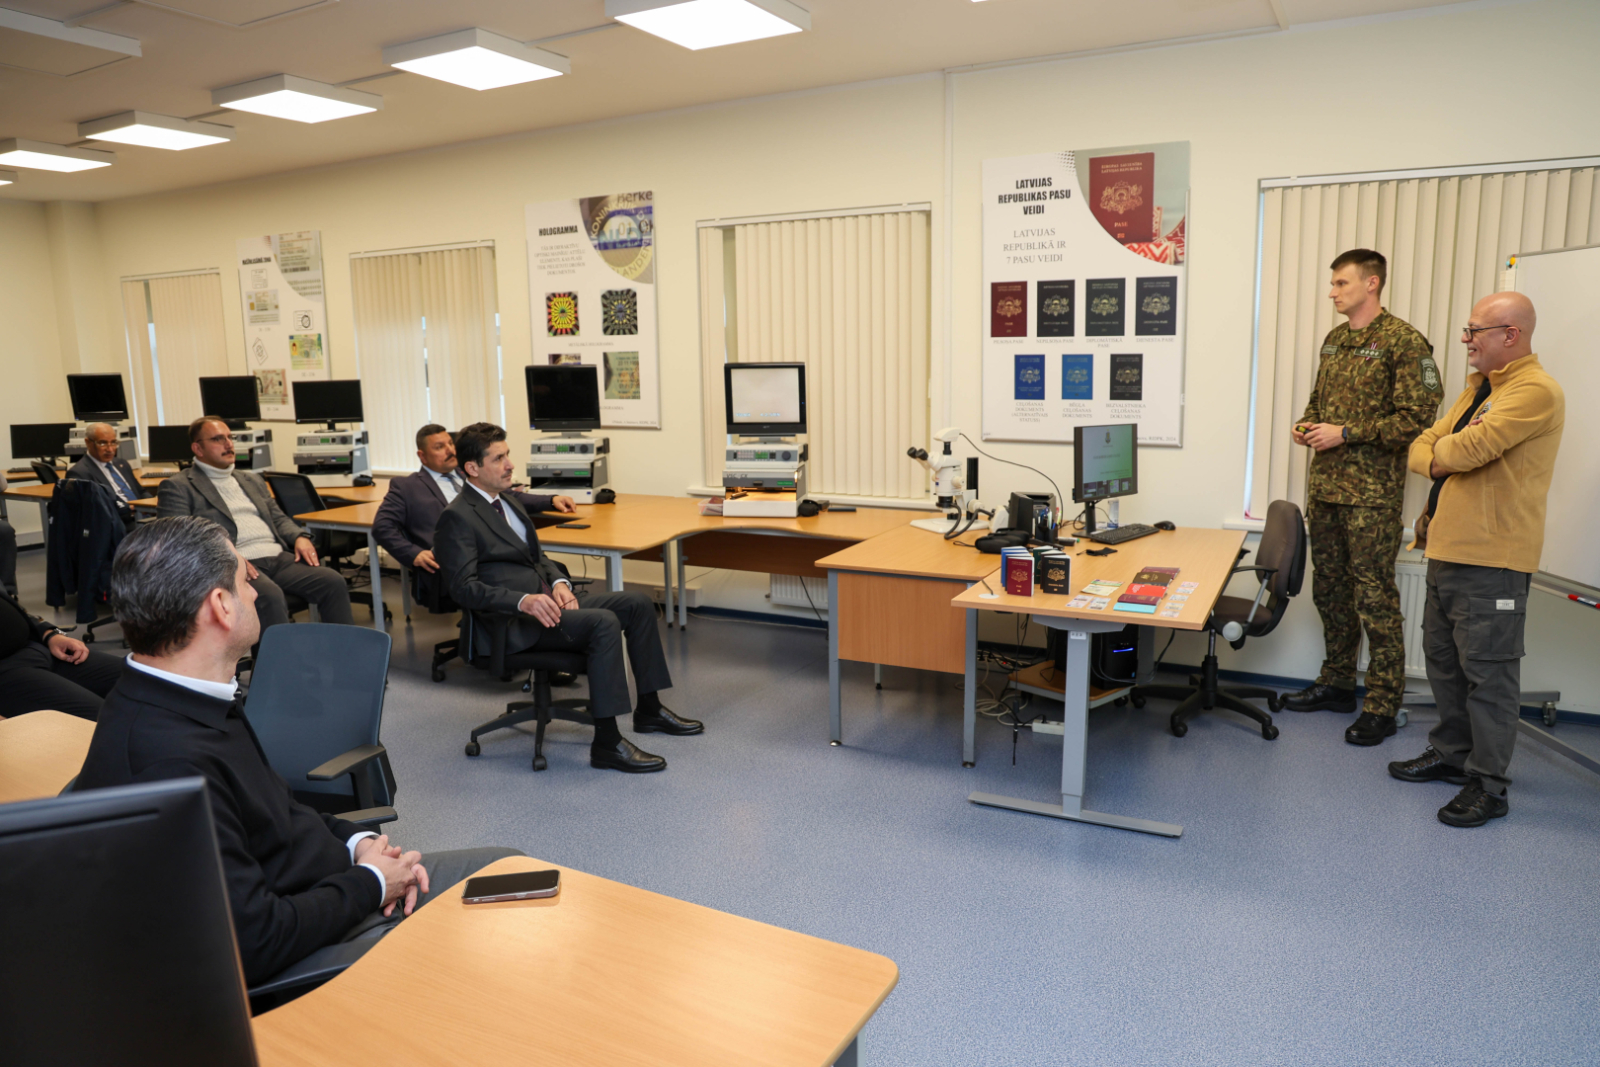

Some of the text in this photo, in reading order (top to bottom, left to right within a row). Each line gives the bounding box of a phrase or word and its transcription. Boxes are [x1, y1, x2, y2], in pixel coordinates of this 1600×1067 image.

[1016, 177, 1052, 189] LATVIJAS
[998, 189, 1071, 204] REPUBLIKAS PASU
[1023, 204, 1044, 215] VEIDI
[539, 225, 578, 236] HOLOGRAMMA
[1013, 228, 1055, 238] LATVIJAS
[1003, 240, 1066, 251] REPUBLIKĀ IR
[1006, 254, 1063, 264] 7 PASU VEIDI
